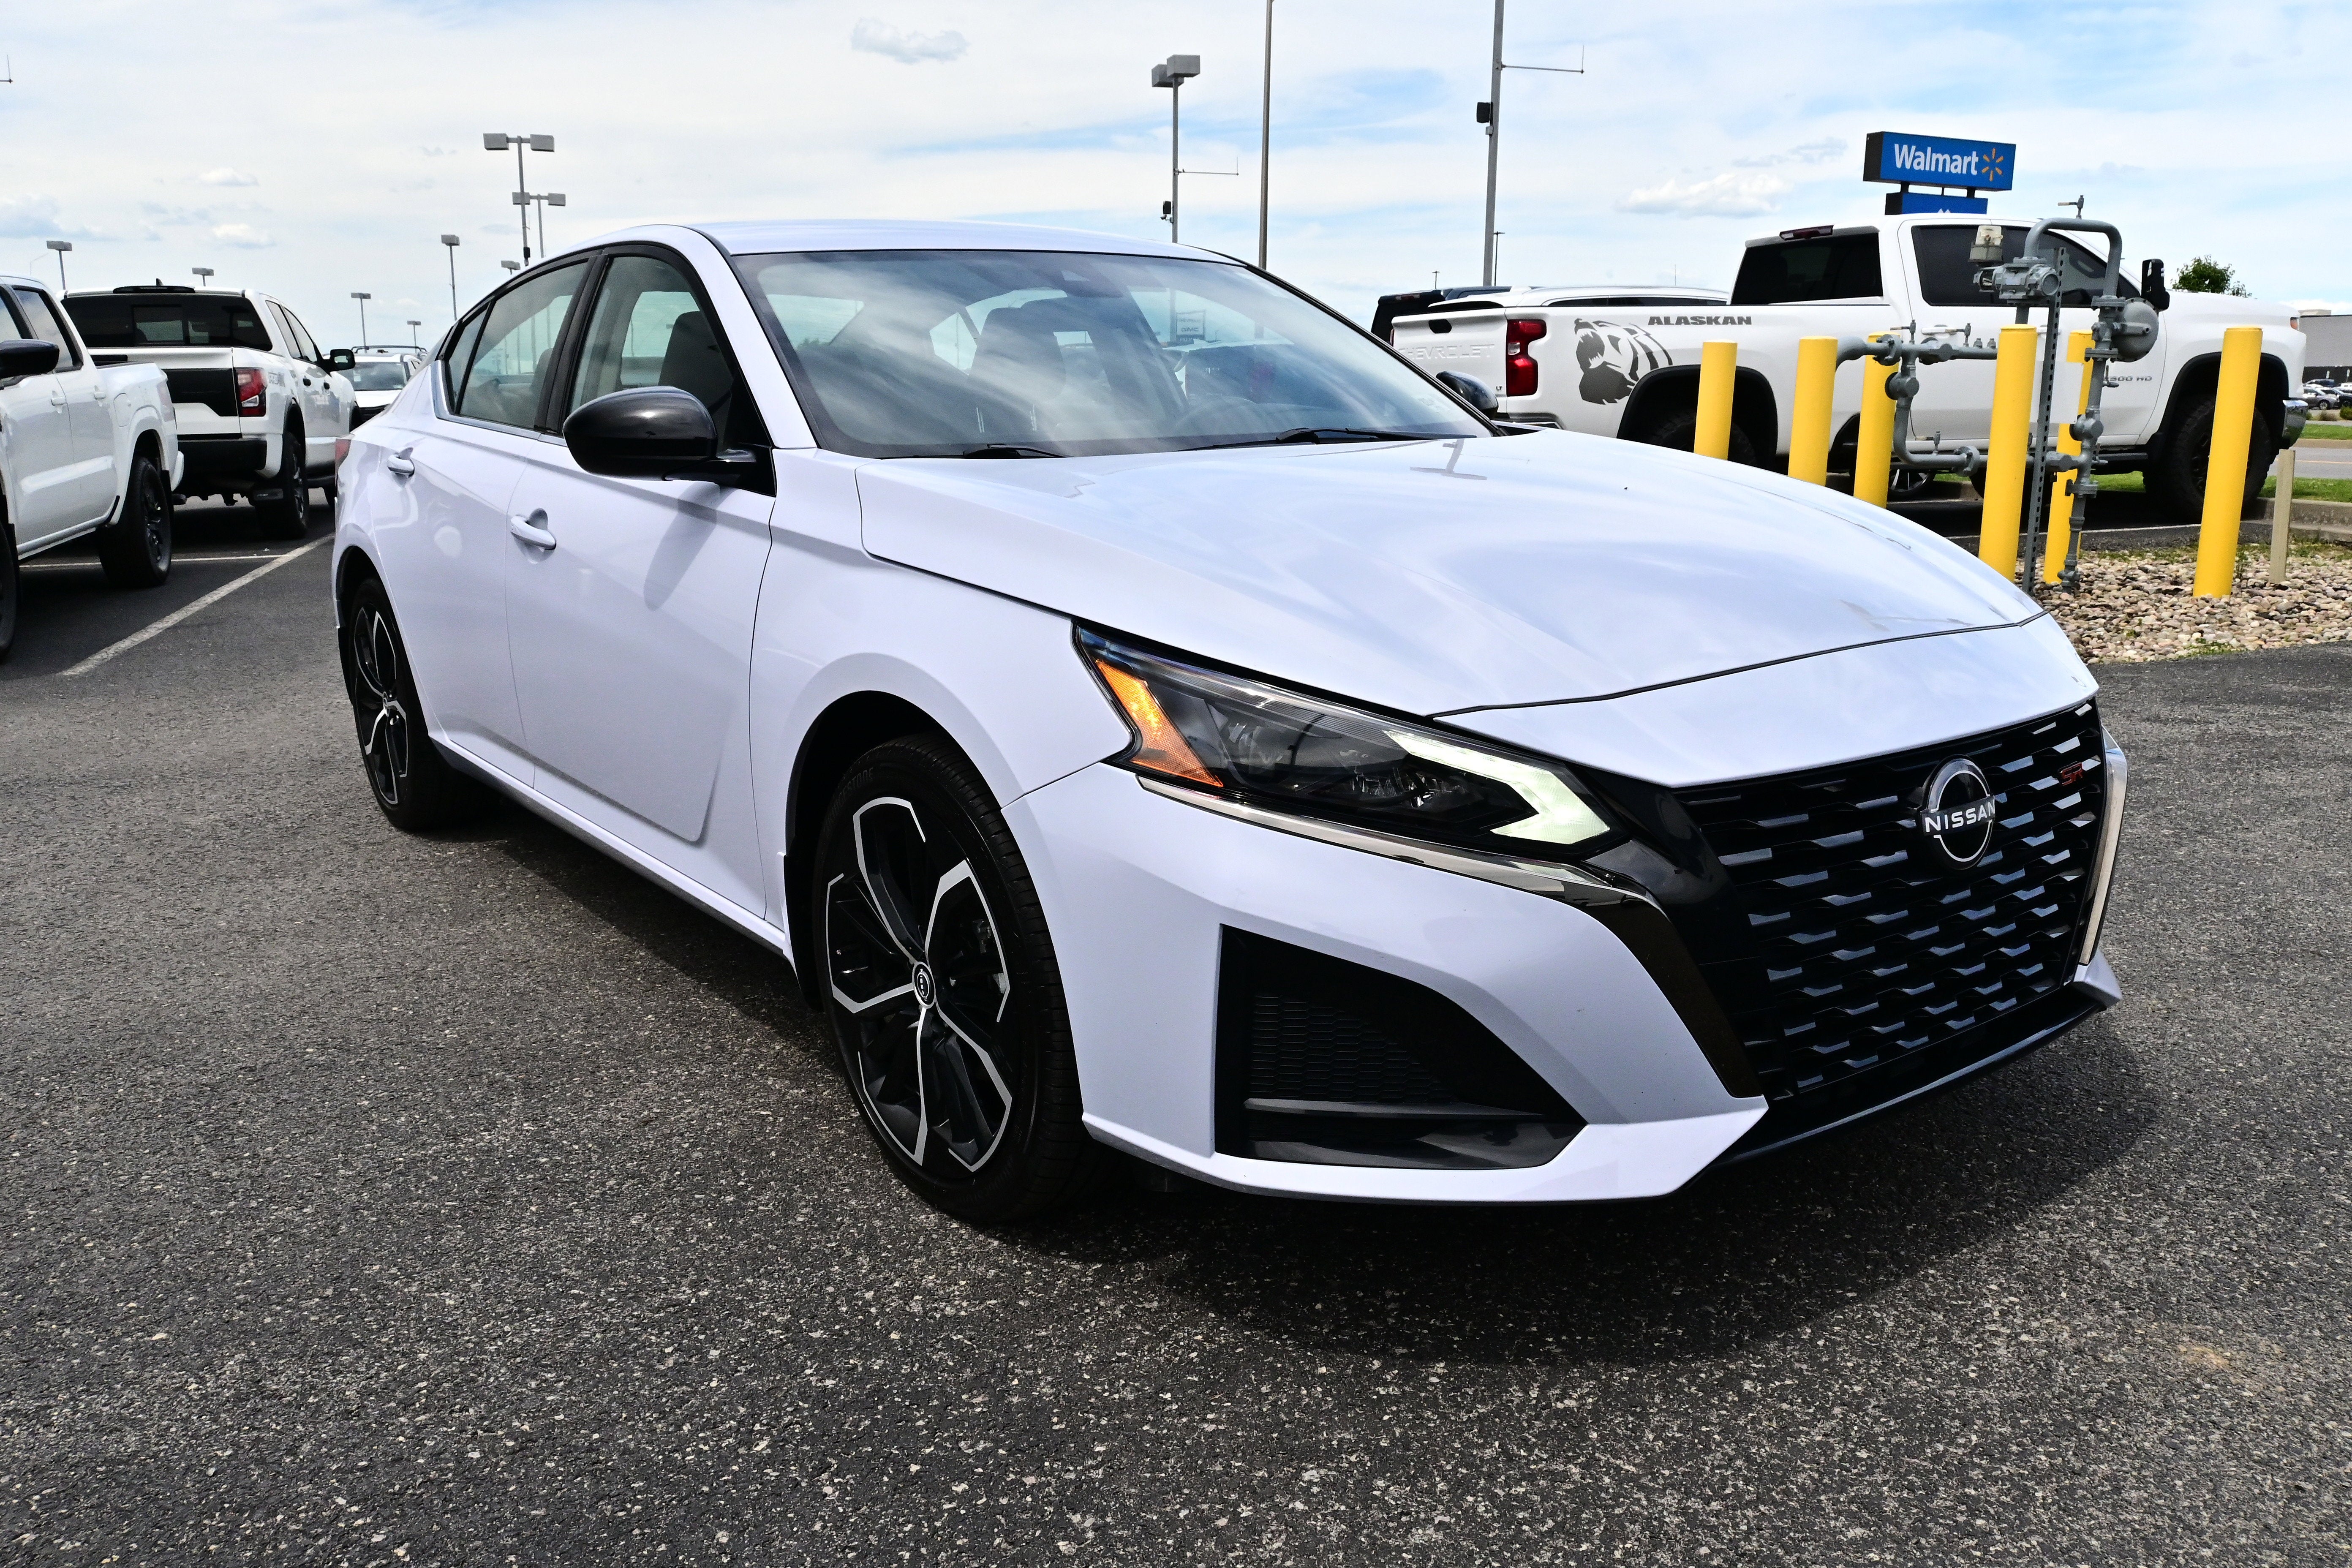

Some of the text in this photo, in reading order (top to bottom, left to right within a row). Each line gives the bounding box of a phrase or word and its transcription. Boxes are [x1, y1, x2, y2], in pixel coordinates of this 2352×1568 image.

[1894, 144, 1979, 175] Walmart
[1648, 316, 1752, 325] ALASKAN
[2061, 762, 2082, 786] SR
[1925, 799, 1995, 833] NISSAN
